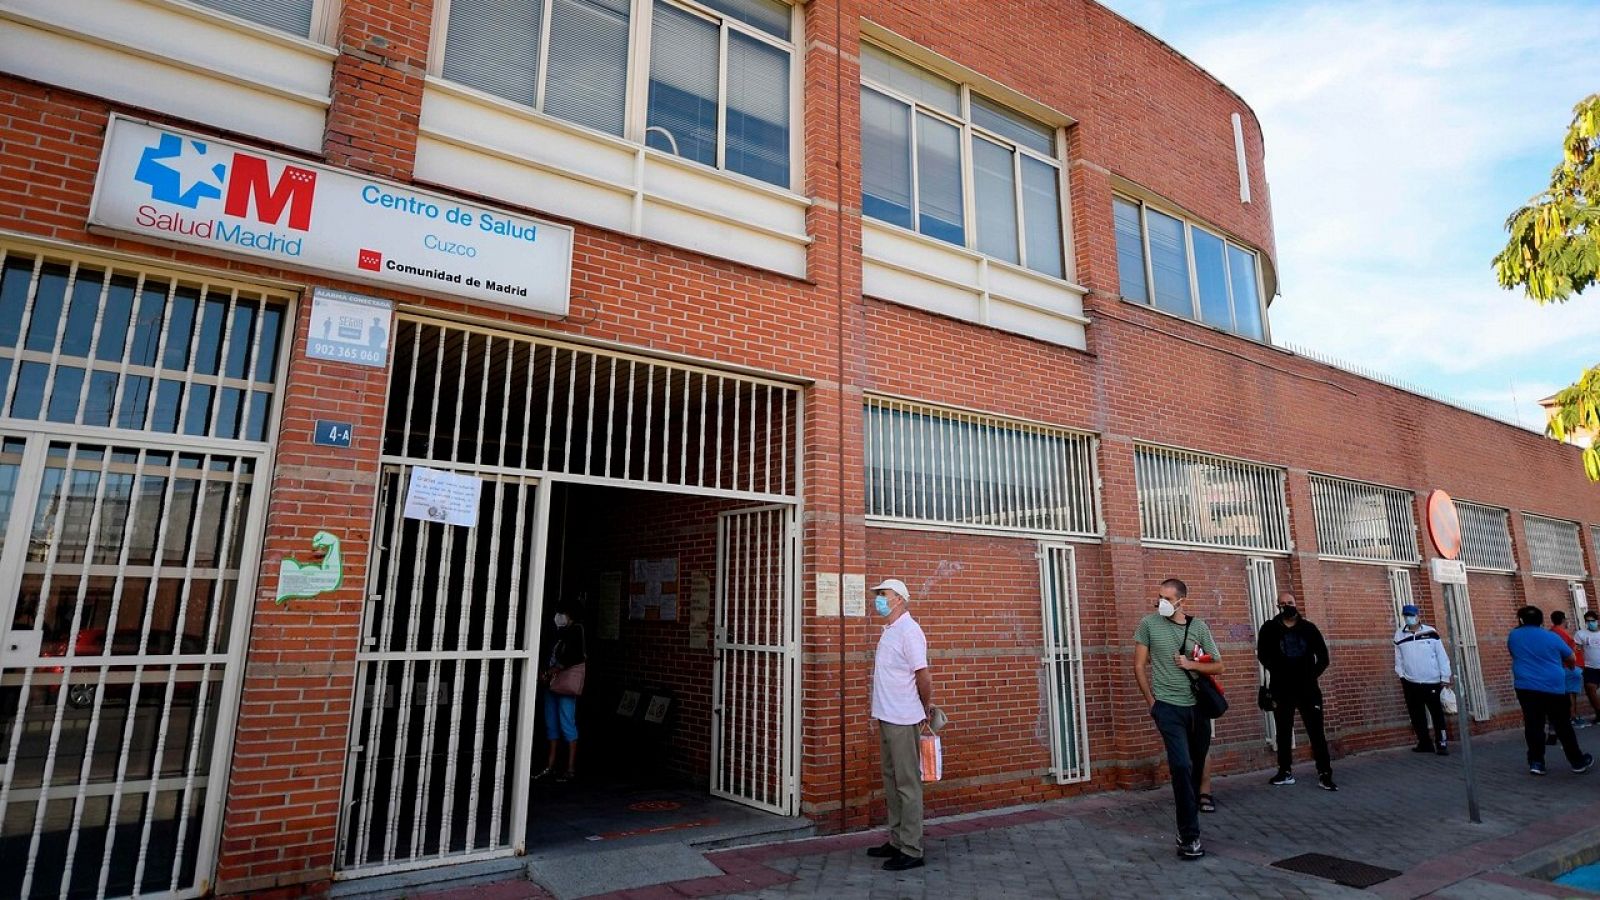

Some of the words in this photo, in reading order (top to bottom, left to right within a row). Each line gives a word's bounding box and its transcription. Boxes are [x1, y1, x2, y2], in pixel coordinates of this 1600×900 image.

[361, 184, 439, 220] Centro
[445, 206, 473, 227] de
[480, 213, 537, 243] Salud
[424, 234, 477, 259] Cuzco
[385, 259, 462, 283] Comunidad
[465, 277, 481, 287] de
[486, 280, 528, 298] Madrid
[317, 291, 347, 301] ALARMA
[315, 343, 335, 355] 902
[337, 346, 356, 359] 365
[360, 351, 380, 362] 060
[329, 426, 349, 442] 4-A
